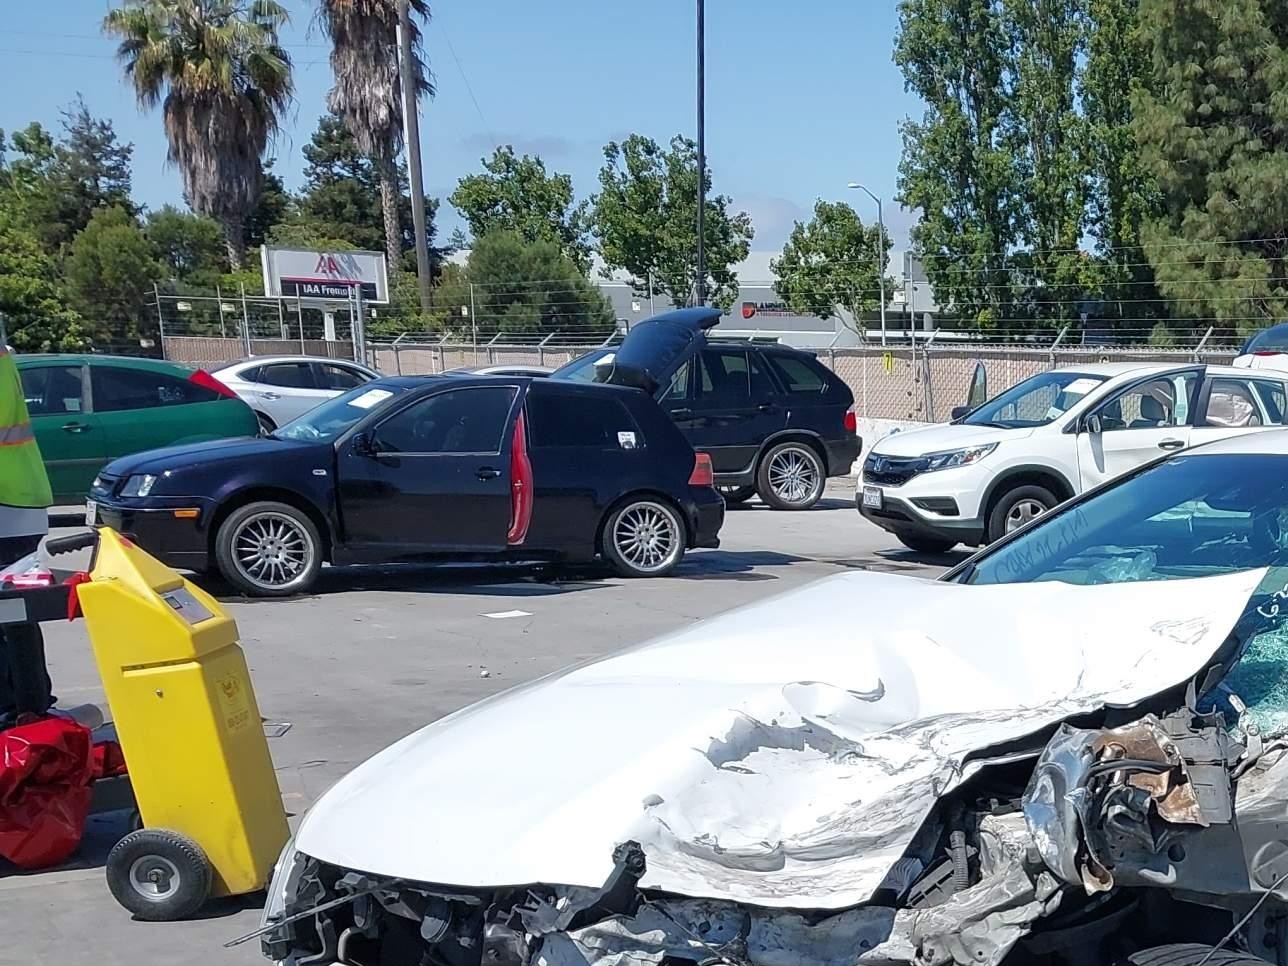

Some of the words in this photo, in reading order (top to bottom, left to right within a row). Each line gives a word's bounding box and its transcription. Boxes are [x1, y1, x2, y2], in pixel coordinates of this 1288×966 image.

[303, 283, 321, 295] IAA
[321, 284, 357, 297] Fremon
[885, 354, 891, 371] 7
